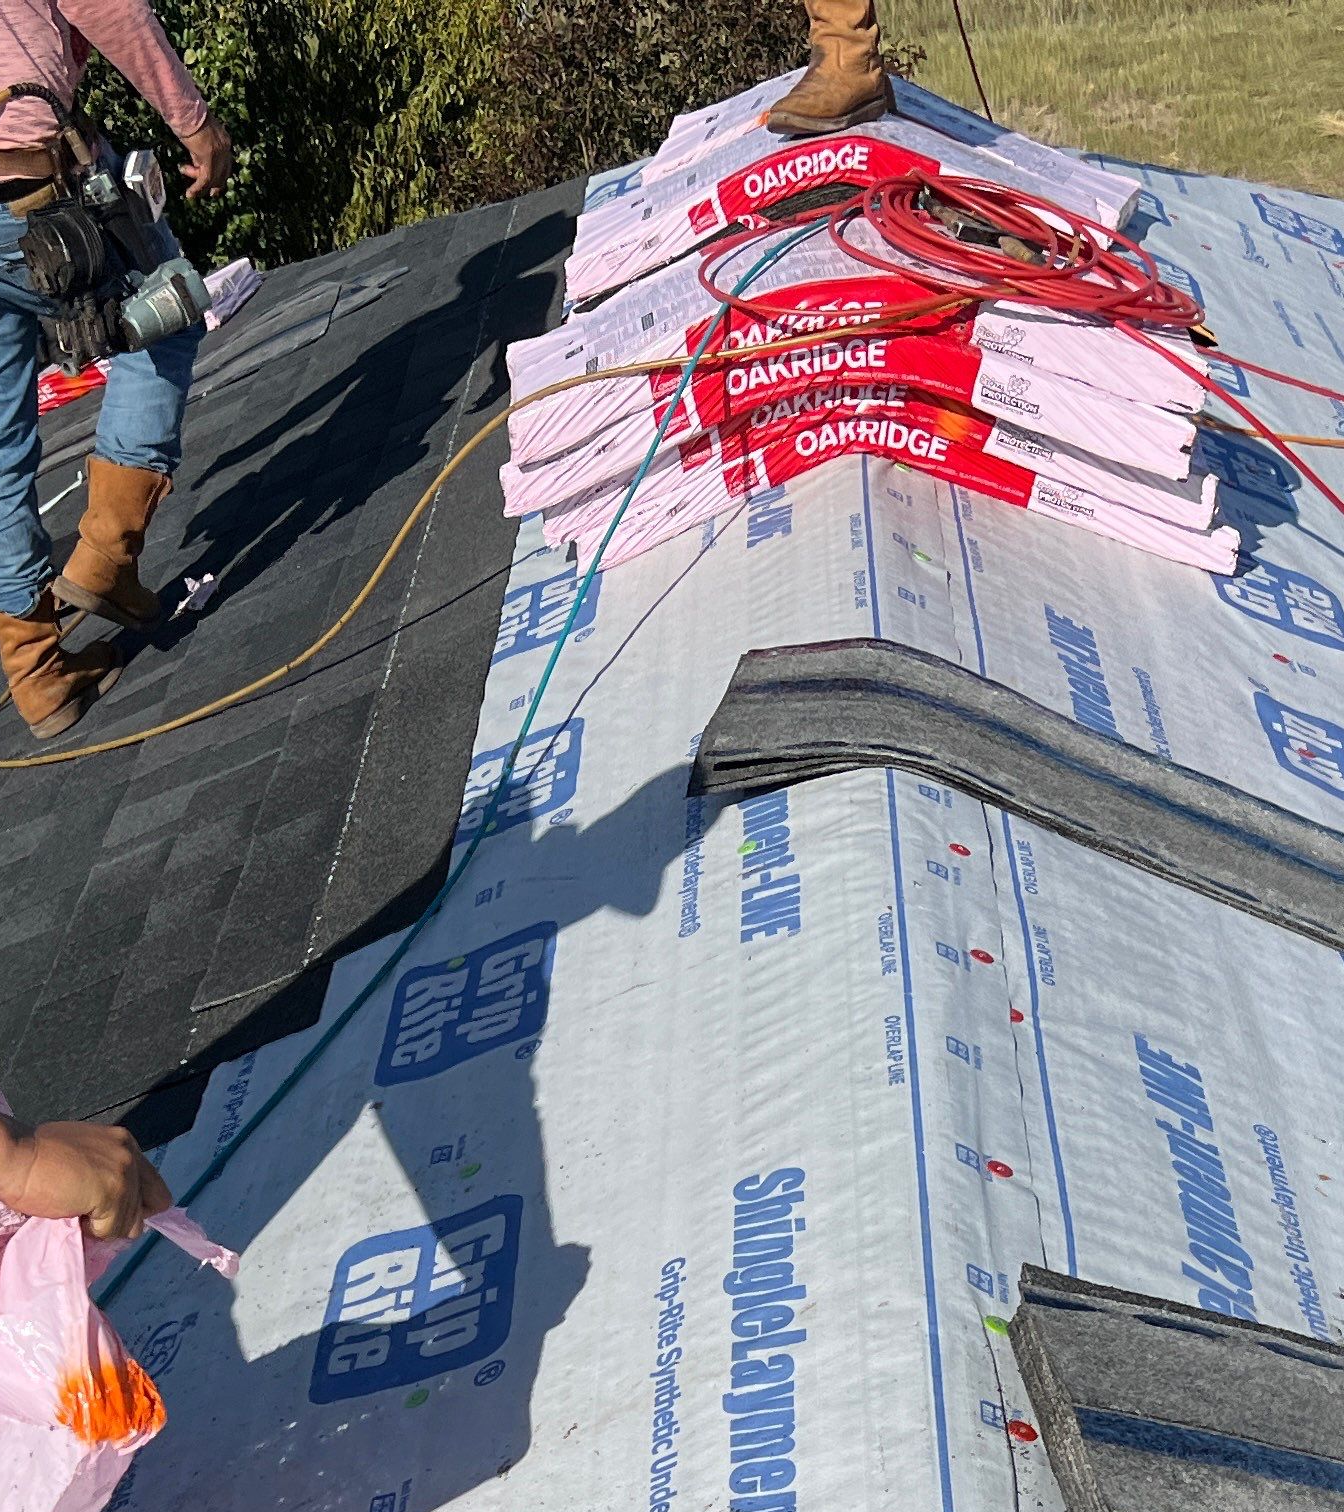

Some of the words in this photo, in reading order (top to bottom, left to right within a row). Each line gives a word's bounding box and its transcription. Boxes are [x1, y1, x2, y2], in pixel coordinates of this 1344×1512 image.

[743, 143, 870, 199] OAKRIDGE
[726, 339, 887, 396] OAKRIDGE
[751, 382, 909, 428] OAKRIDGE
[795, 418, 950, 462] OAKRIDGE
[390, 967, 470, 1068] Rite
[456, 938, 545, 1045] Grip
[327, 1246, 424, 1376] Rite
[405, 1212, 507, 1358] Grip
[655, 1256, 687, 1347] Grip-Rite
[649, 1347, 682, 1456] Synthetic
